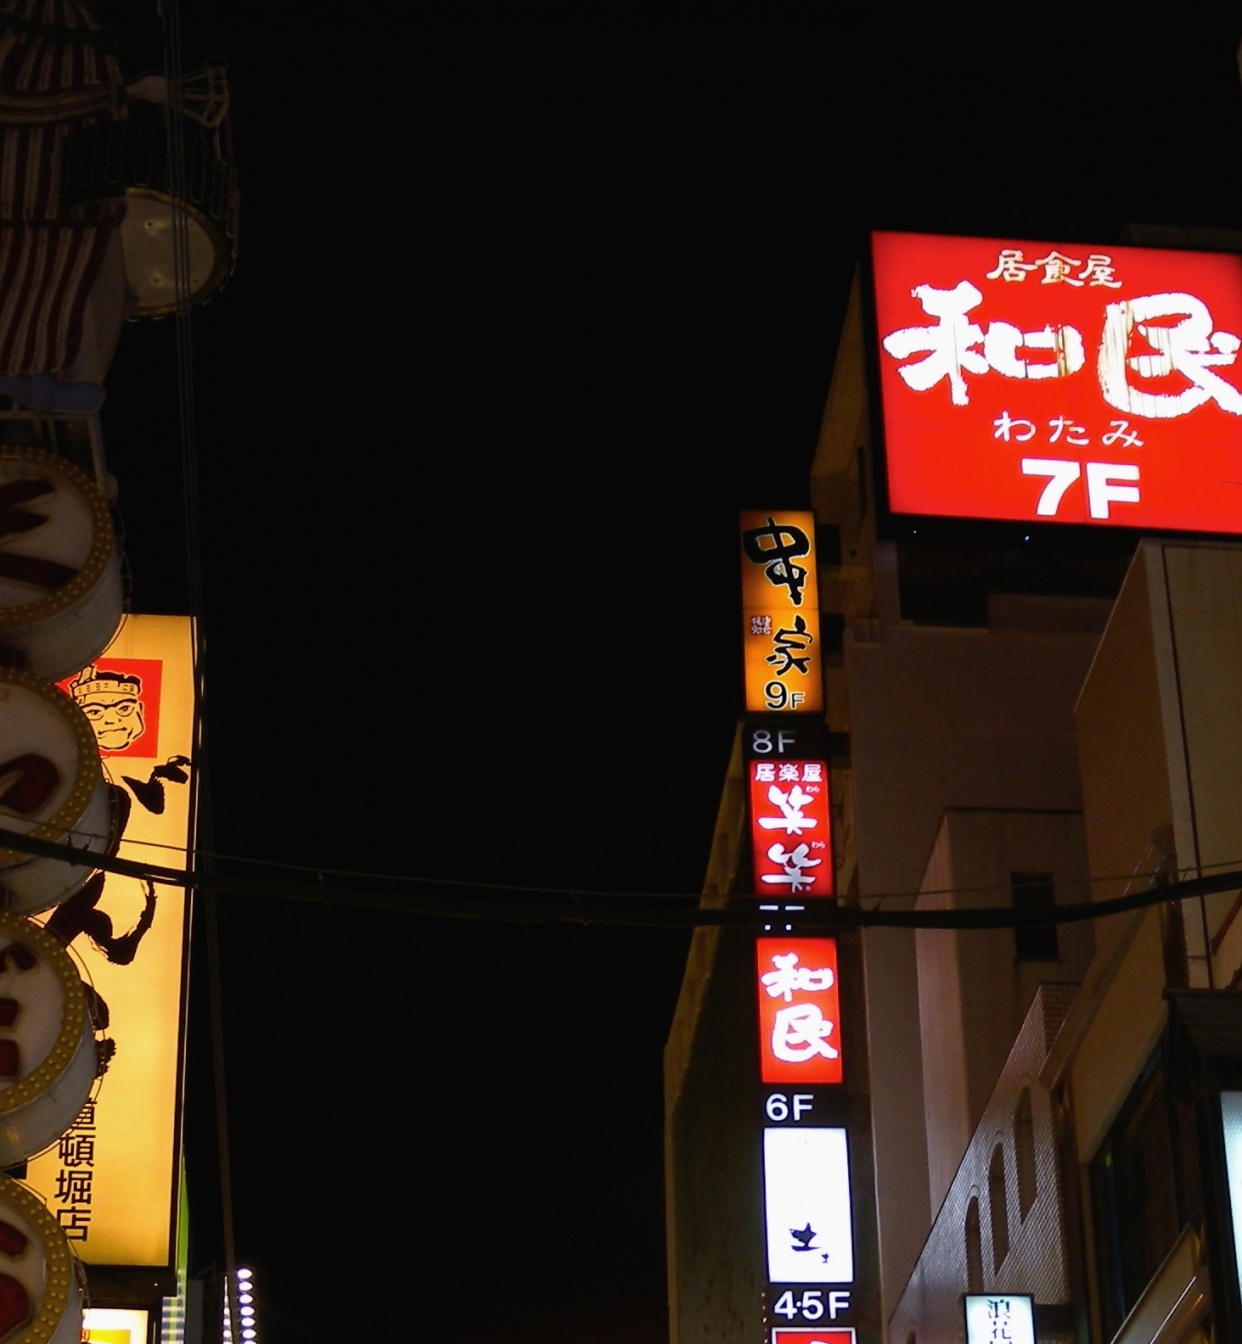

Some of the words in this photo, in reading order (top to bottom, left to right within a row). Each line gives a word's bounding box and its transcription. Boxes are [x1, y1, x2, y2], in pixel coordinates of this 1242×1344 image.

[987, 249, 1122, 289] 居食屋
[883, 281, 1242, 419] 和民
[993, 411, 1144, 447] わたみ
[1021, 458, 1140, 518] 7F
[765, 681, 804, 710] 9F
[753, 730, 796, 753] 8F
[755, 763, 823, 782] 居楽屋
[761, 952, 838, 1062] 和民
[766, 1094, 814, 1121] 6F
